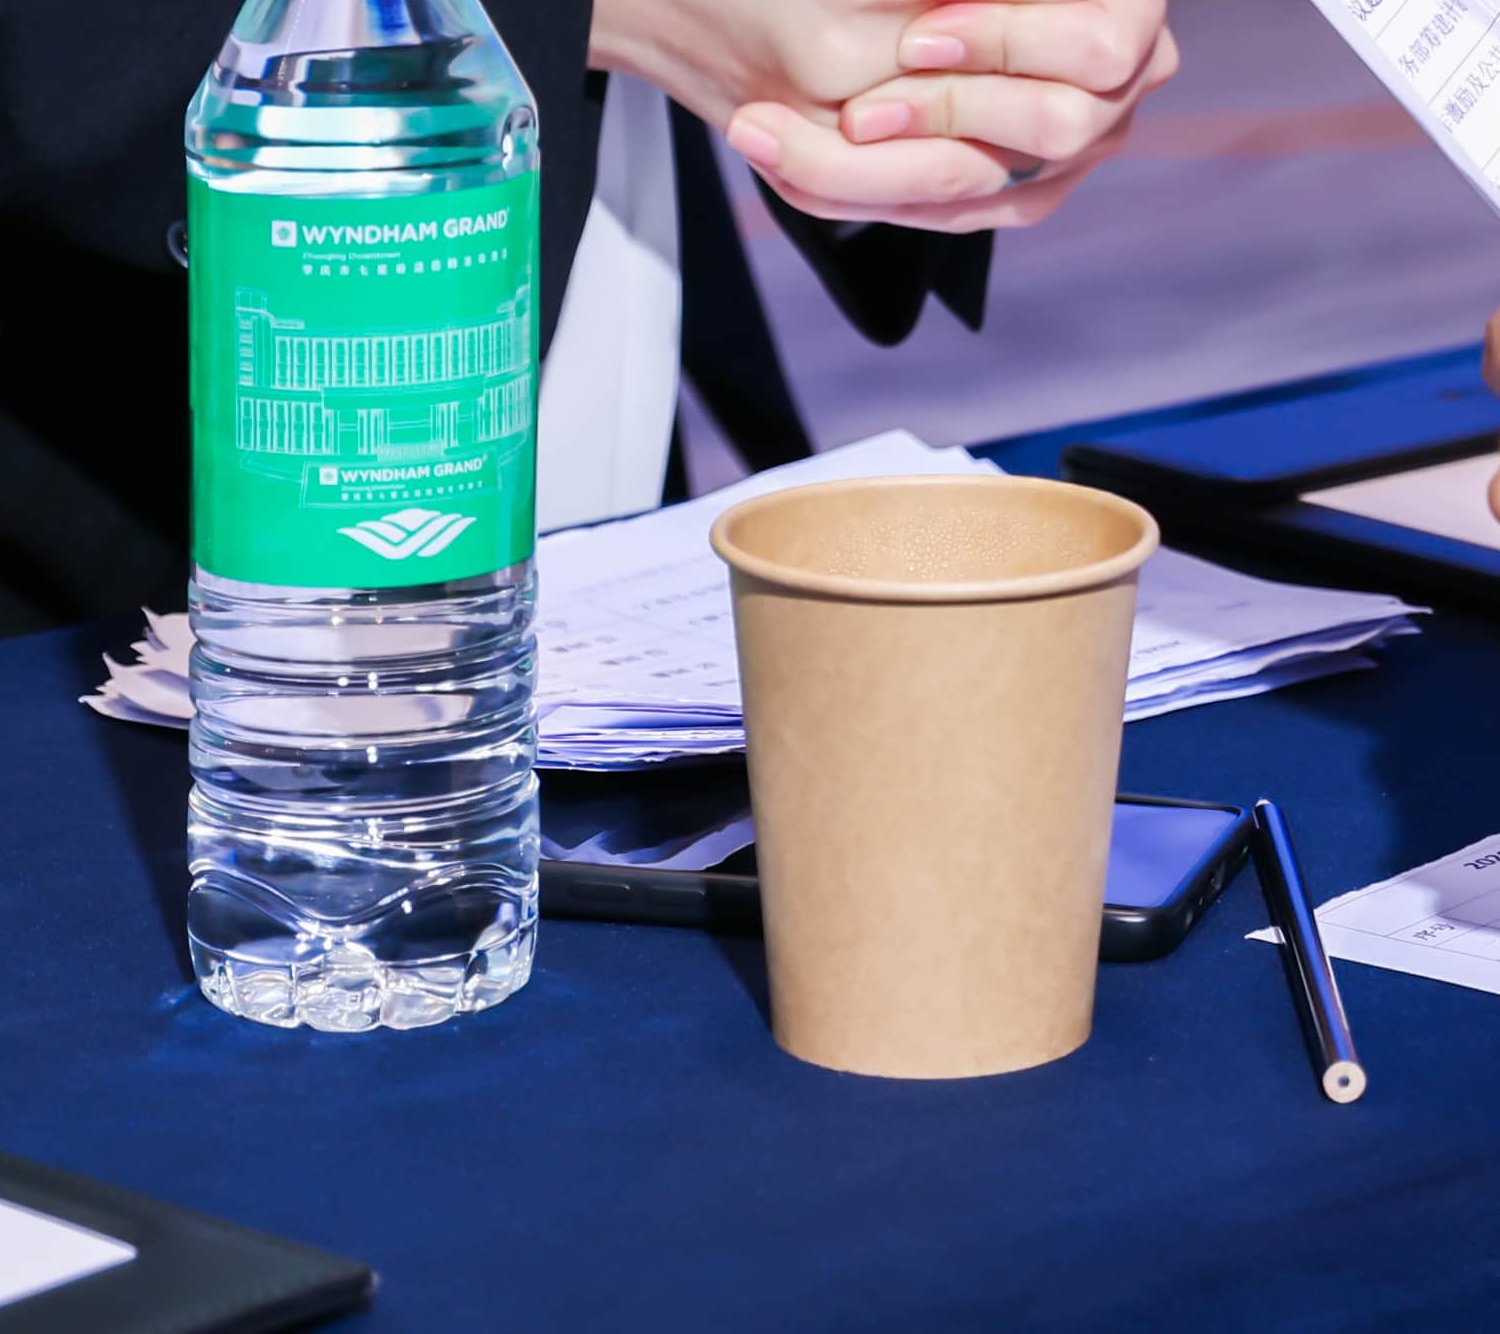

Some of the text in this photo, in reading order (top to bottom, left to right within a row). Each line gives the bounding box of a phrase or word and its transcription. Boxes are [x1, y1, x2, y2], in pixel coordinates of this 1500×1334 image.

[302, 209, 508, 245] WYNDHAM GRAND
[341, 458, 482, 483] WYNDHAM GRAND
[1411, 923, 1455, 941] 序号
